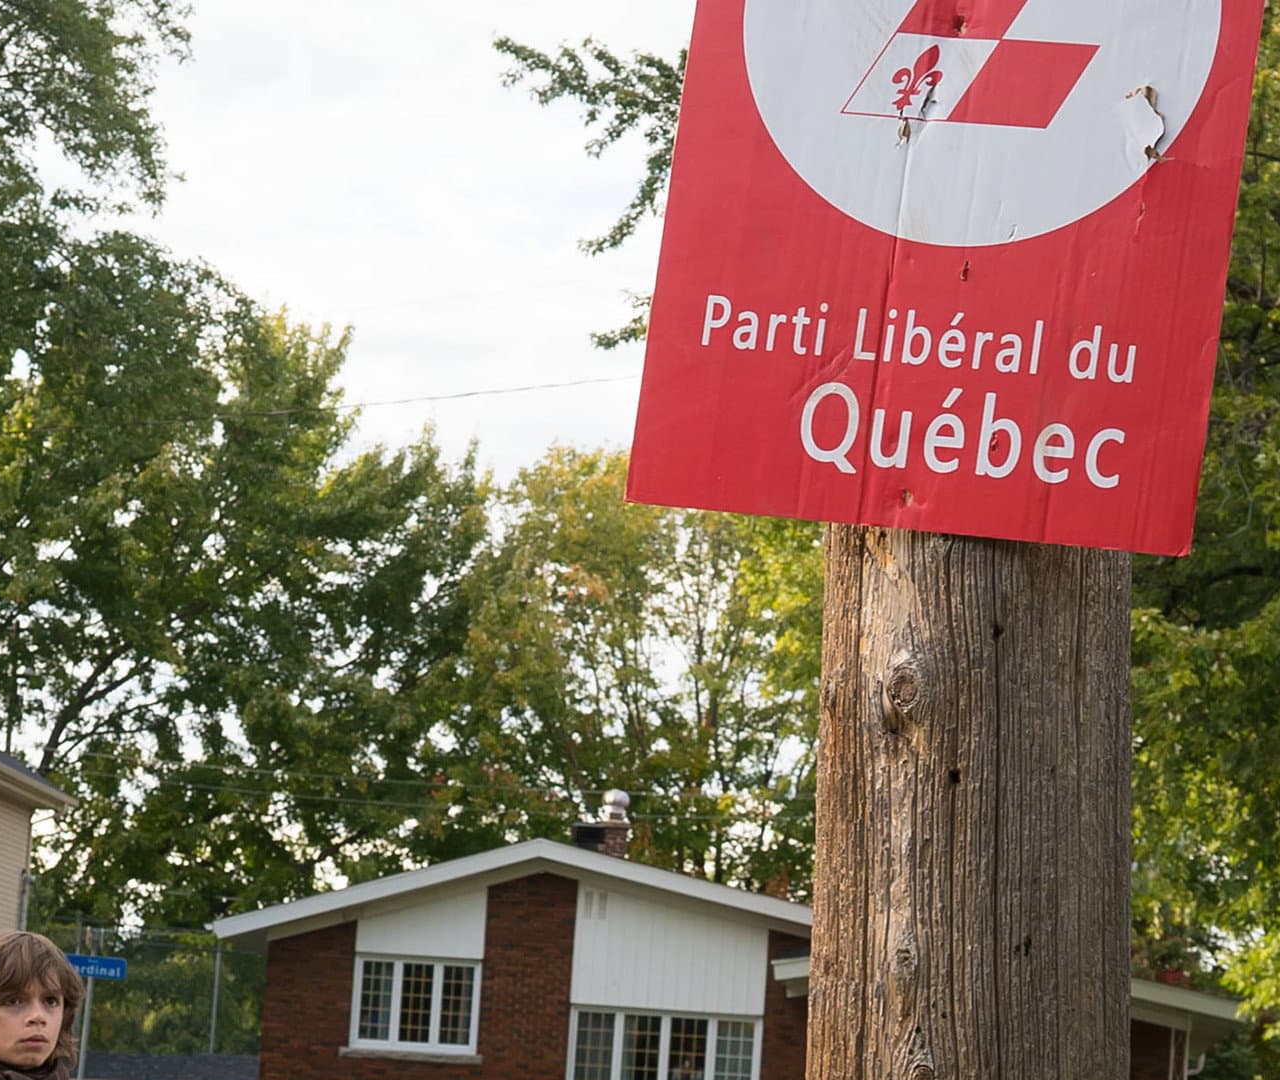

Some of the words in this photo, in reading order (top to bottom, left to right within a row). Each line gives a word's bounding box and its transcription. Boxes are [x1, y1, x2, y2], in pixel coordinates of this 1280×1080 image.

[701, 294, 830, 357] Parti
[853, 307, 1045, 376] Libéral
[1068, 325, 1137, 384] du
[800, 382, 1126, 490] Québec
